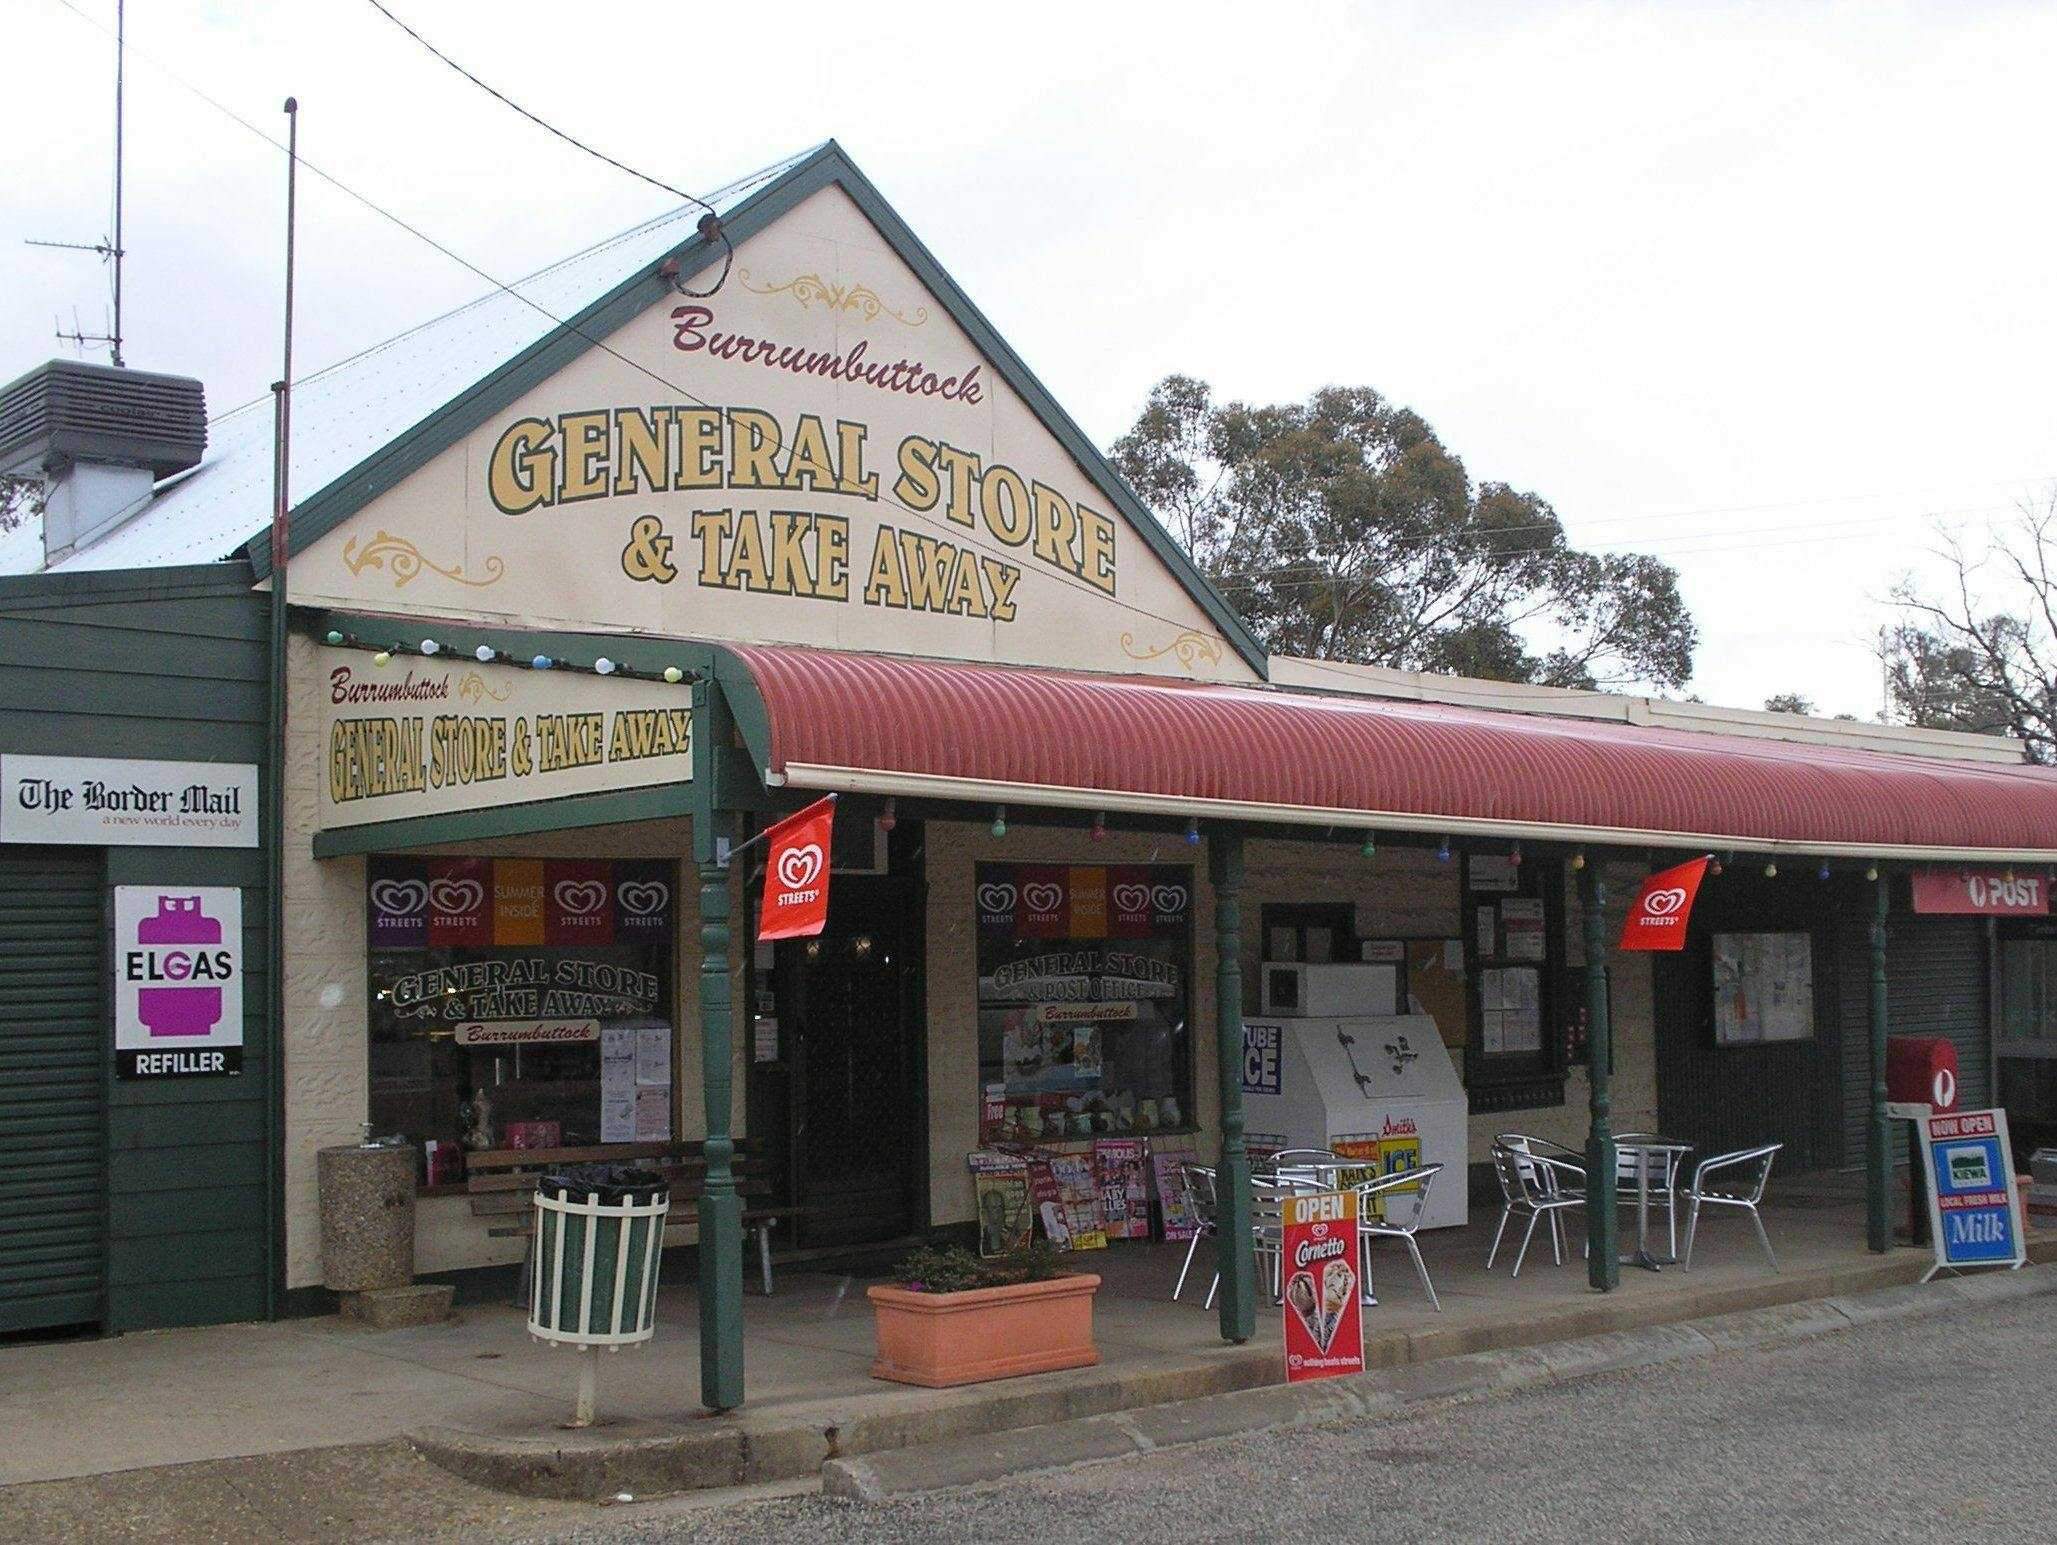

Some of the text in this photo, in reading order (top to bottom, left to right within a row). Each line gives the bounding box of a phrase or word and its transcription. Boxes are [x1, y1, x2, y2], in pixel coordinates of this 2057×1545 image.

[670, 305, 985, 406] Burrumbuttock
[488, 406, 1117, 597] GENERAL STORE
[621, 510, 1021, 622] & TAKE AWAY
[330, 665, 450, 705] Burrumbuttock
[330, 708, 693, 804] GENERAL STORE & TAKE AWAY
[18, 778, 241, 815] The Border Mail
[113, 816, 140, 826] new
[144, 814, 180, 827] world
[182, 816, 216, 830] every
[220, 817, 242, 832] day
[777, 889, 816, 907] STREETS
[1988, 877, 2040, 908] POST
[377, 917, 423, 928] STREETS
[432, 917, 478, 927] STREETS
[560, 917, 602, 926] STREETS
[624, 917, 664, 927] STREETS
[1640, 916, 1676, 926] STREETS
[126, 950, 233, 981] ELGAS
[993, 951, 1180, 990] GENERAL STORE
[392, 959, 660, 1008] GENERAL STORE
[443, 990, 611, 1020] & TAKE AWAY
[467, 1024, 591, 1042] Burrumbuttock
[136, 1052, 225, 1075] REFILLER
[1931, 1116, 1993, 1137] NOW OPEN
[1295, 1194, 1344, 1223] OPEN
[1952, 1212, 2005, 1244] Milk
[1295, 1237, 1345, 1267] Cornetto
